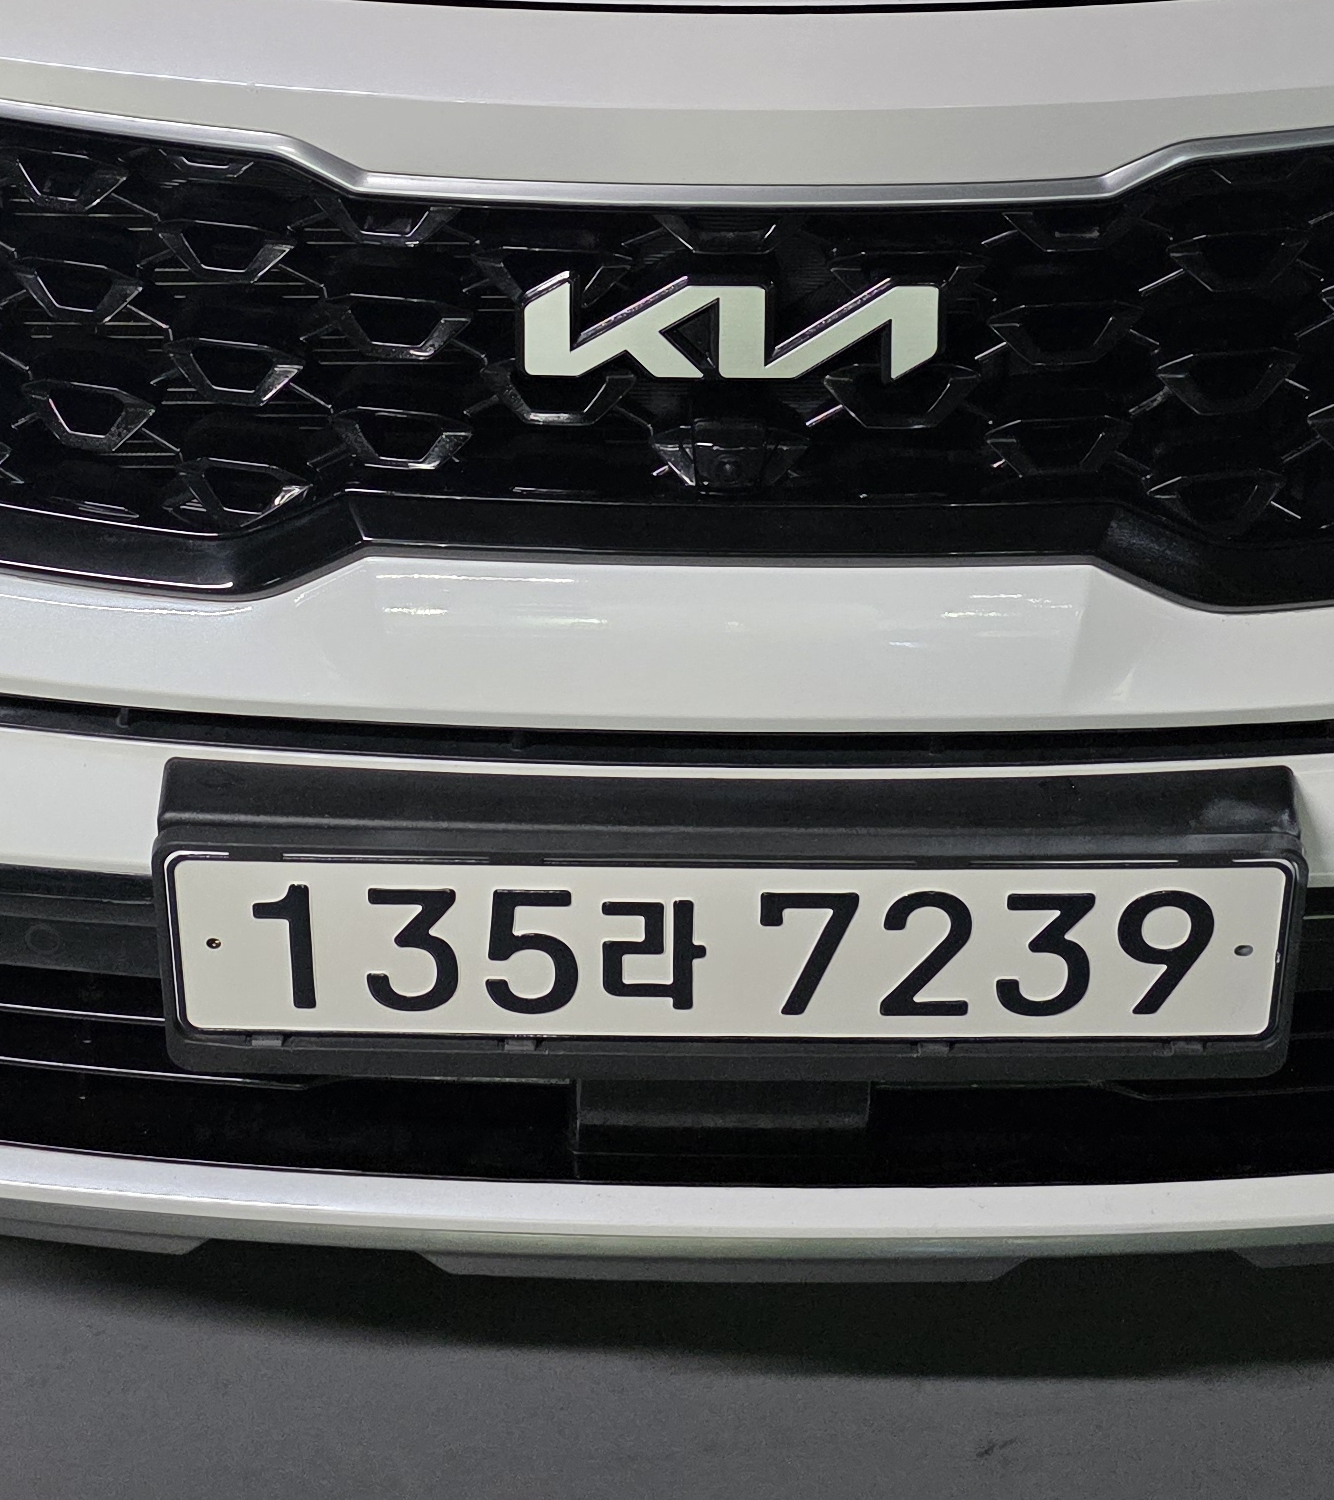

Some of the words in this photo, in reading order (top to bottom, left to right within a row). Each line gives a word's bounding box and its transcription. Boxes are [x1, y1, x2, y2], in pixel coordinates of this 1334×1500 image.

[523, 271, 940, 380] KIA
[252, 884, 708, 1014] 135라
[759, 891, 1217, 1018] 7239
